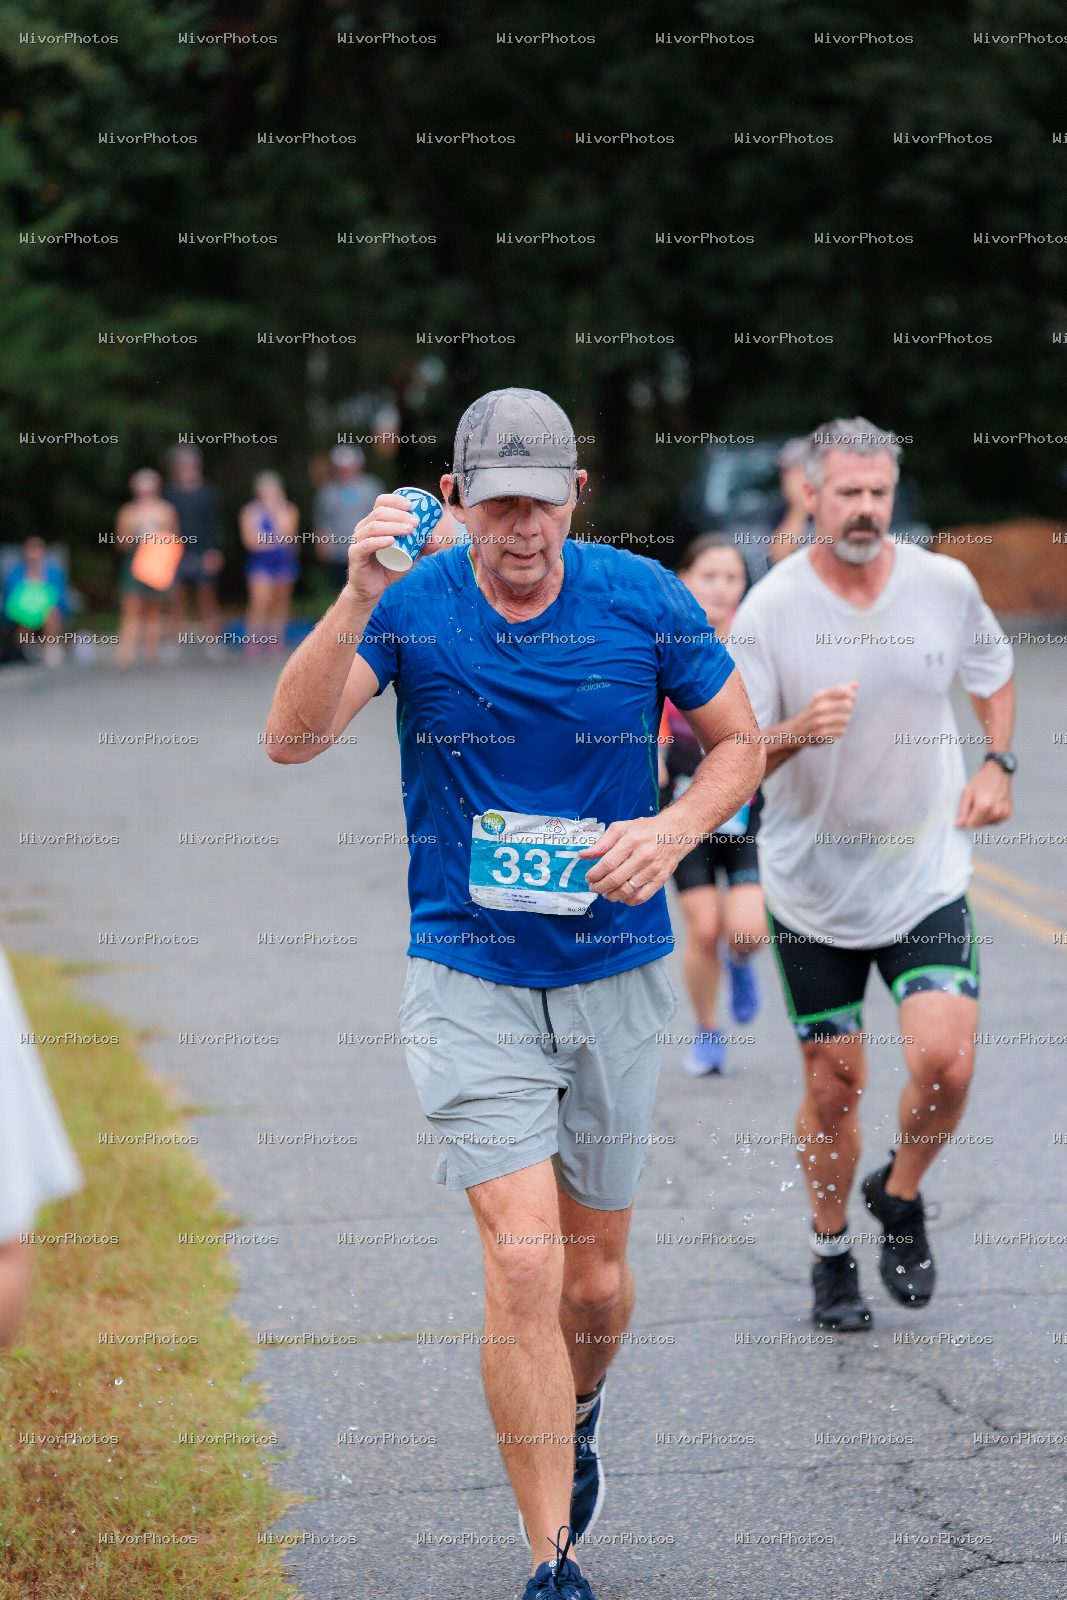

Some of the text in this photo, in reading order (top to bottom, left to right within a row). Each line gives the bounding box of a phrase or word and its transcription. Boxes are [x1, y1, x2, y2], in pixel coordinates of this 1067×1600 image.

[499, 447, 530, 457] adidas
[577, 681, 611, 692] adidas
[492, 847, 583, 888] 337
